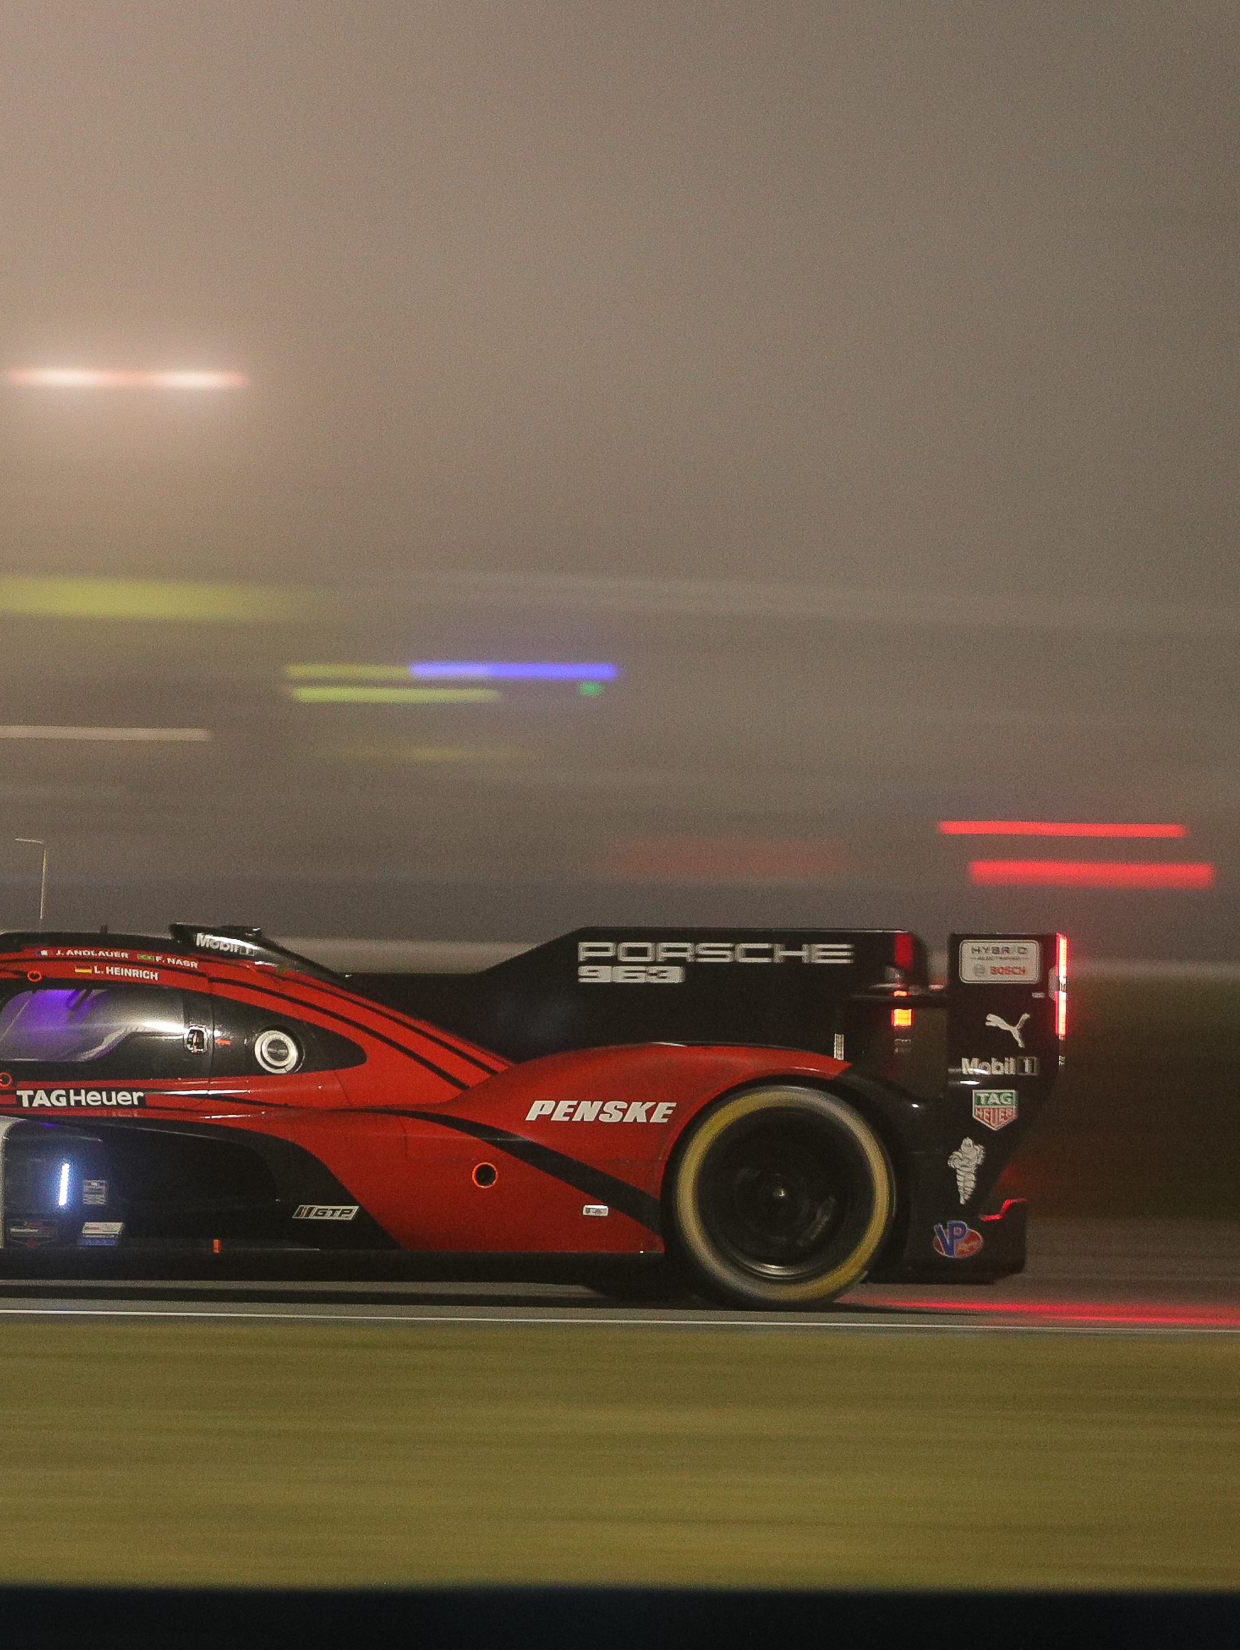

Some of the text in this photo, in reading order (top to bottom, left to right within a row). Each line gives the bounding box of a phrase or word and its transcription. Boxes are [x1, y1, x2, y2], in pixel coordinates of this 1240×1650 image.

[196, 932, 238, 953] Mobil
[65, 949, 130, 959] ANDLAUER
[577, 941, 854, 964] PORSCHE
[166, 957, 199, 969] NASR
[990, 966, 1027, 976] BOSCH
[93, 965, 159, 981] L. HEINRICH
[577, 965, 686, 984] 963
[961, 1057, 1017, 1075] Mobil
[976, 1093, 1013, 1105] TAG
[524, 1100, 678, 1123] PENSKE
[975, 1107, 1014, 1126] HEUER
[313, 1208, 354, 1217] GTP
[933, 1220, 968, 1258] VP
